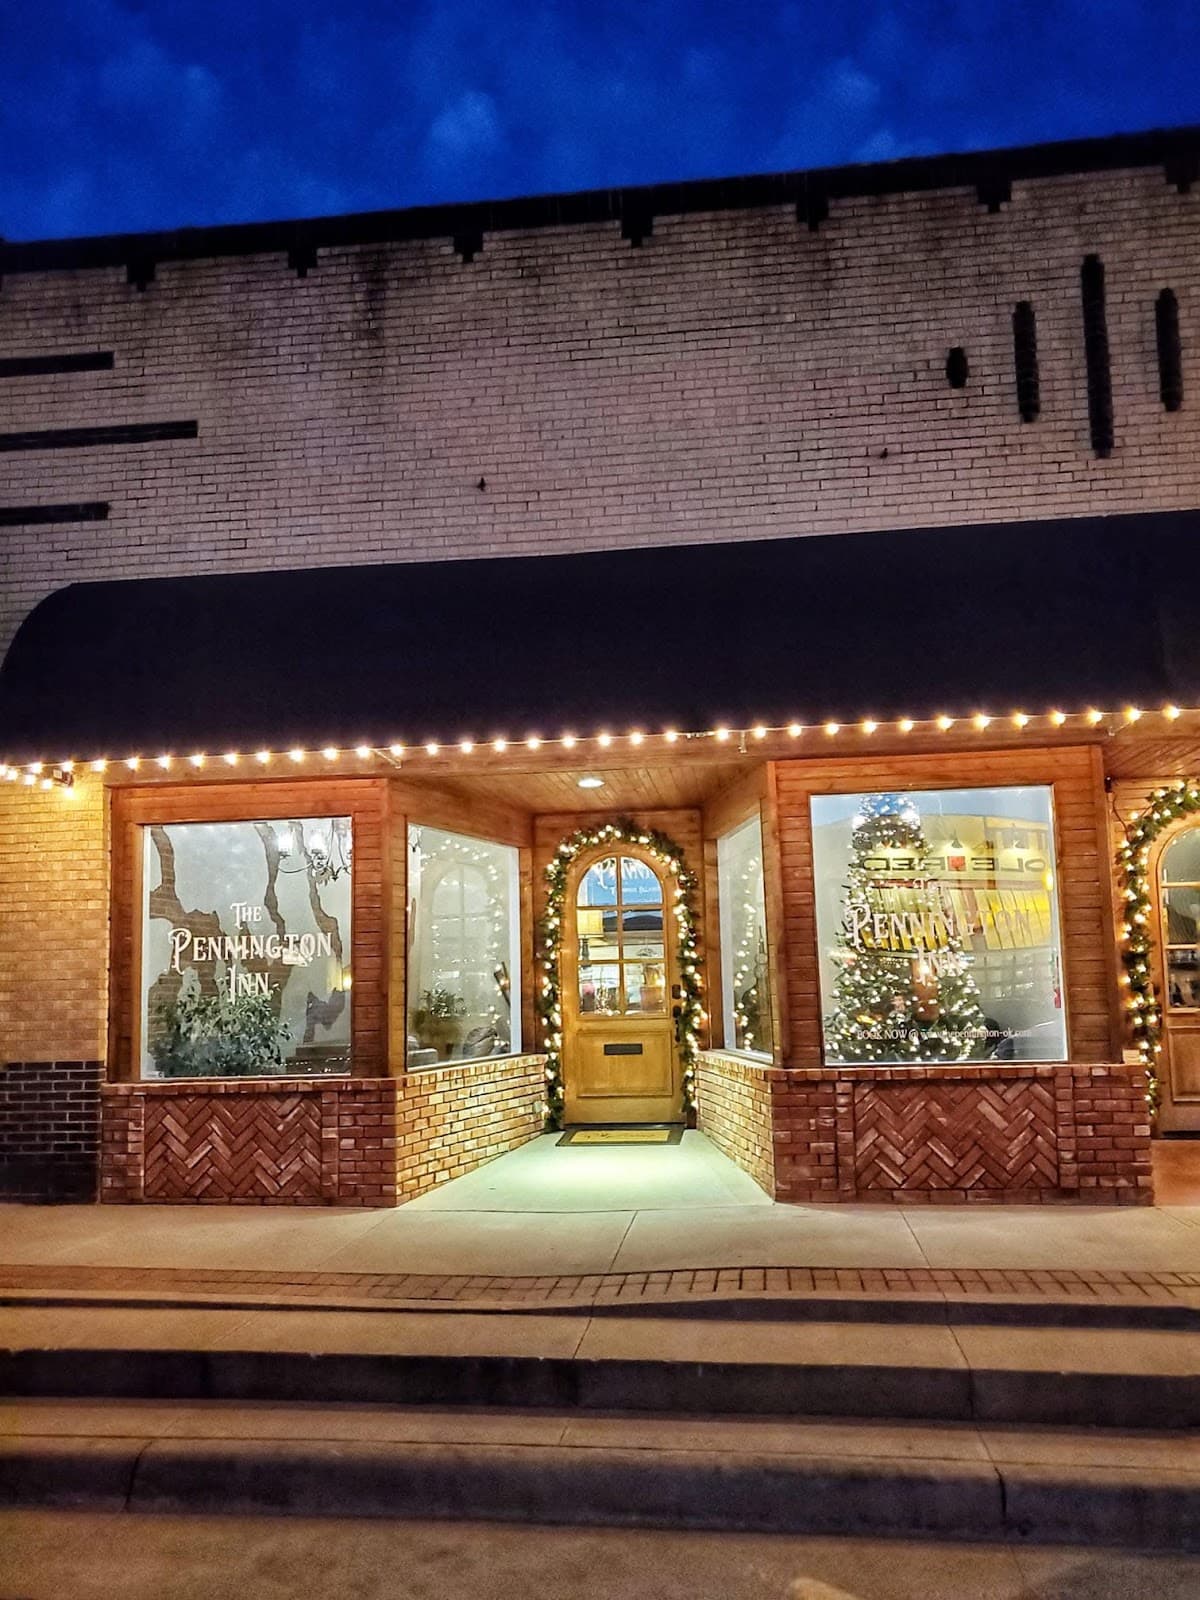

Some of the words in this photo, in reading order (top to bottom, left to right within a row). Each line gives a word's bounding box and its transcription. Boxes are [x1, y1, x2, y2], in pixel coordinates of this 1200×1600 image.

[230, 902, 262, 929] THE
[168, 928, 332, 975] PENNINGTON
[227, 964, 271, 1005] INN
[884, 1029, 907, 1040] NOW
